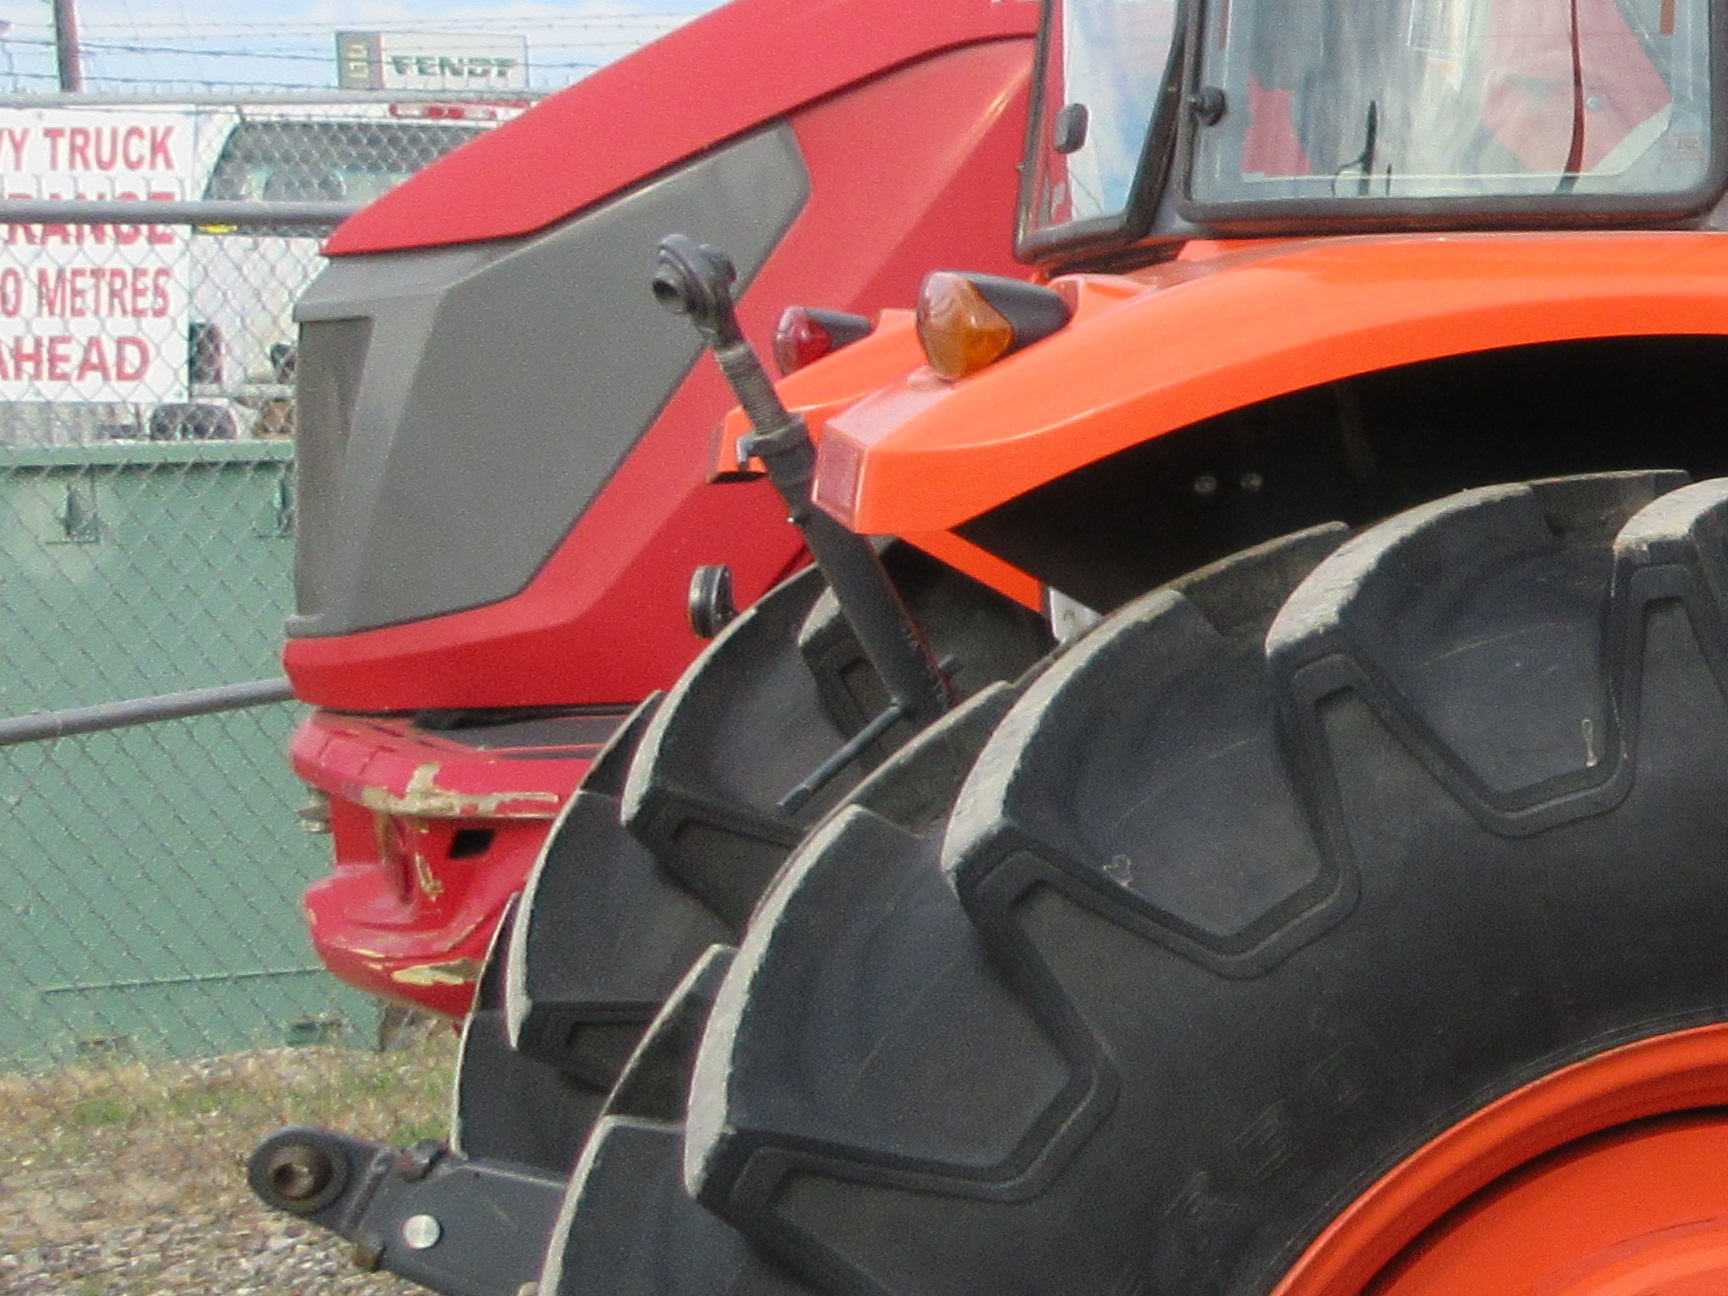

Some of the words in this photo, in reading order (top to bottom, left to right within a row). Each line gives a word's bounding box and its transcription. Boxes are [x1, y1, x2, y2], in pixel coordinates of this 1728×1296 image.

[391, 55, 517, 76] FENDT
[43, 126, 176, 171] TRUCK
[37, 267, 172, 318] METRES
